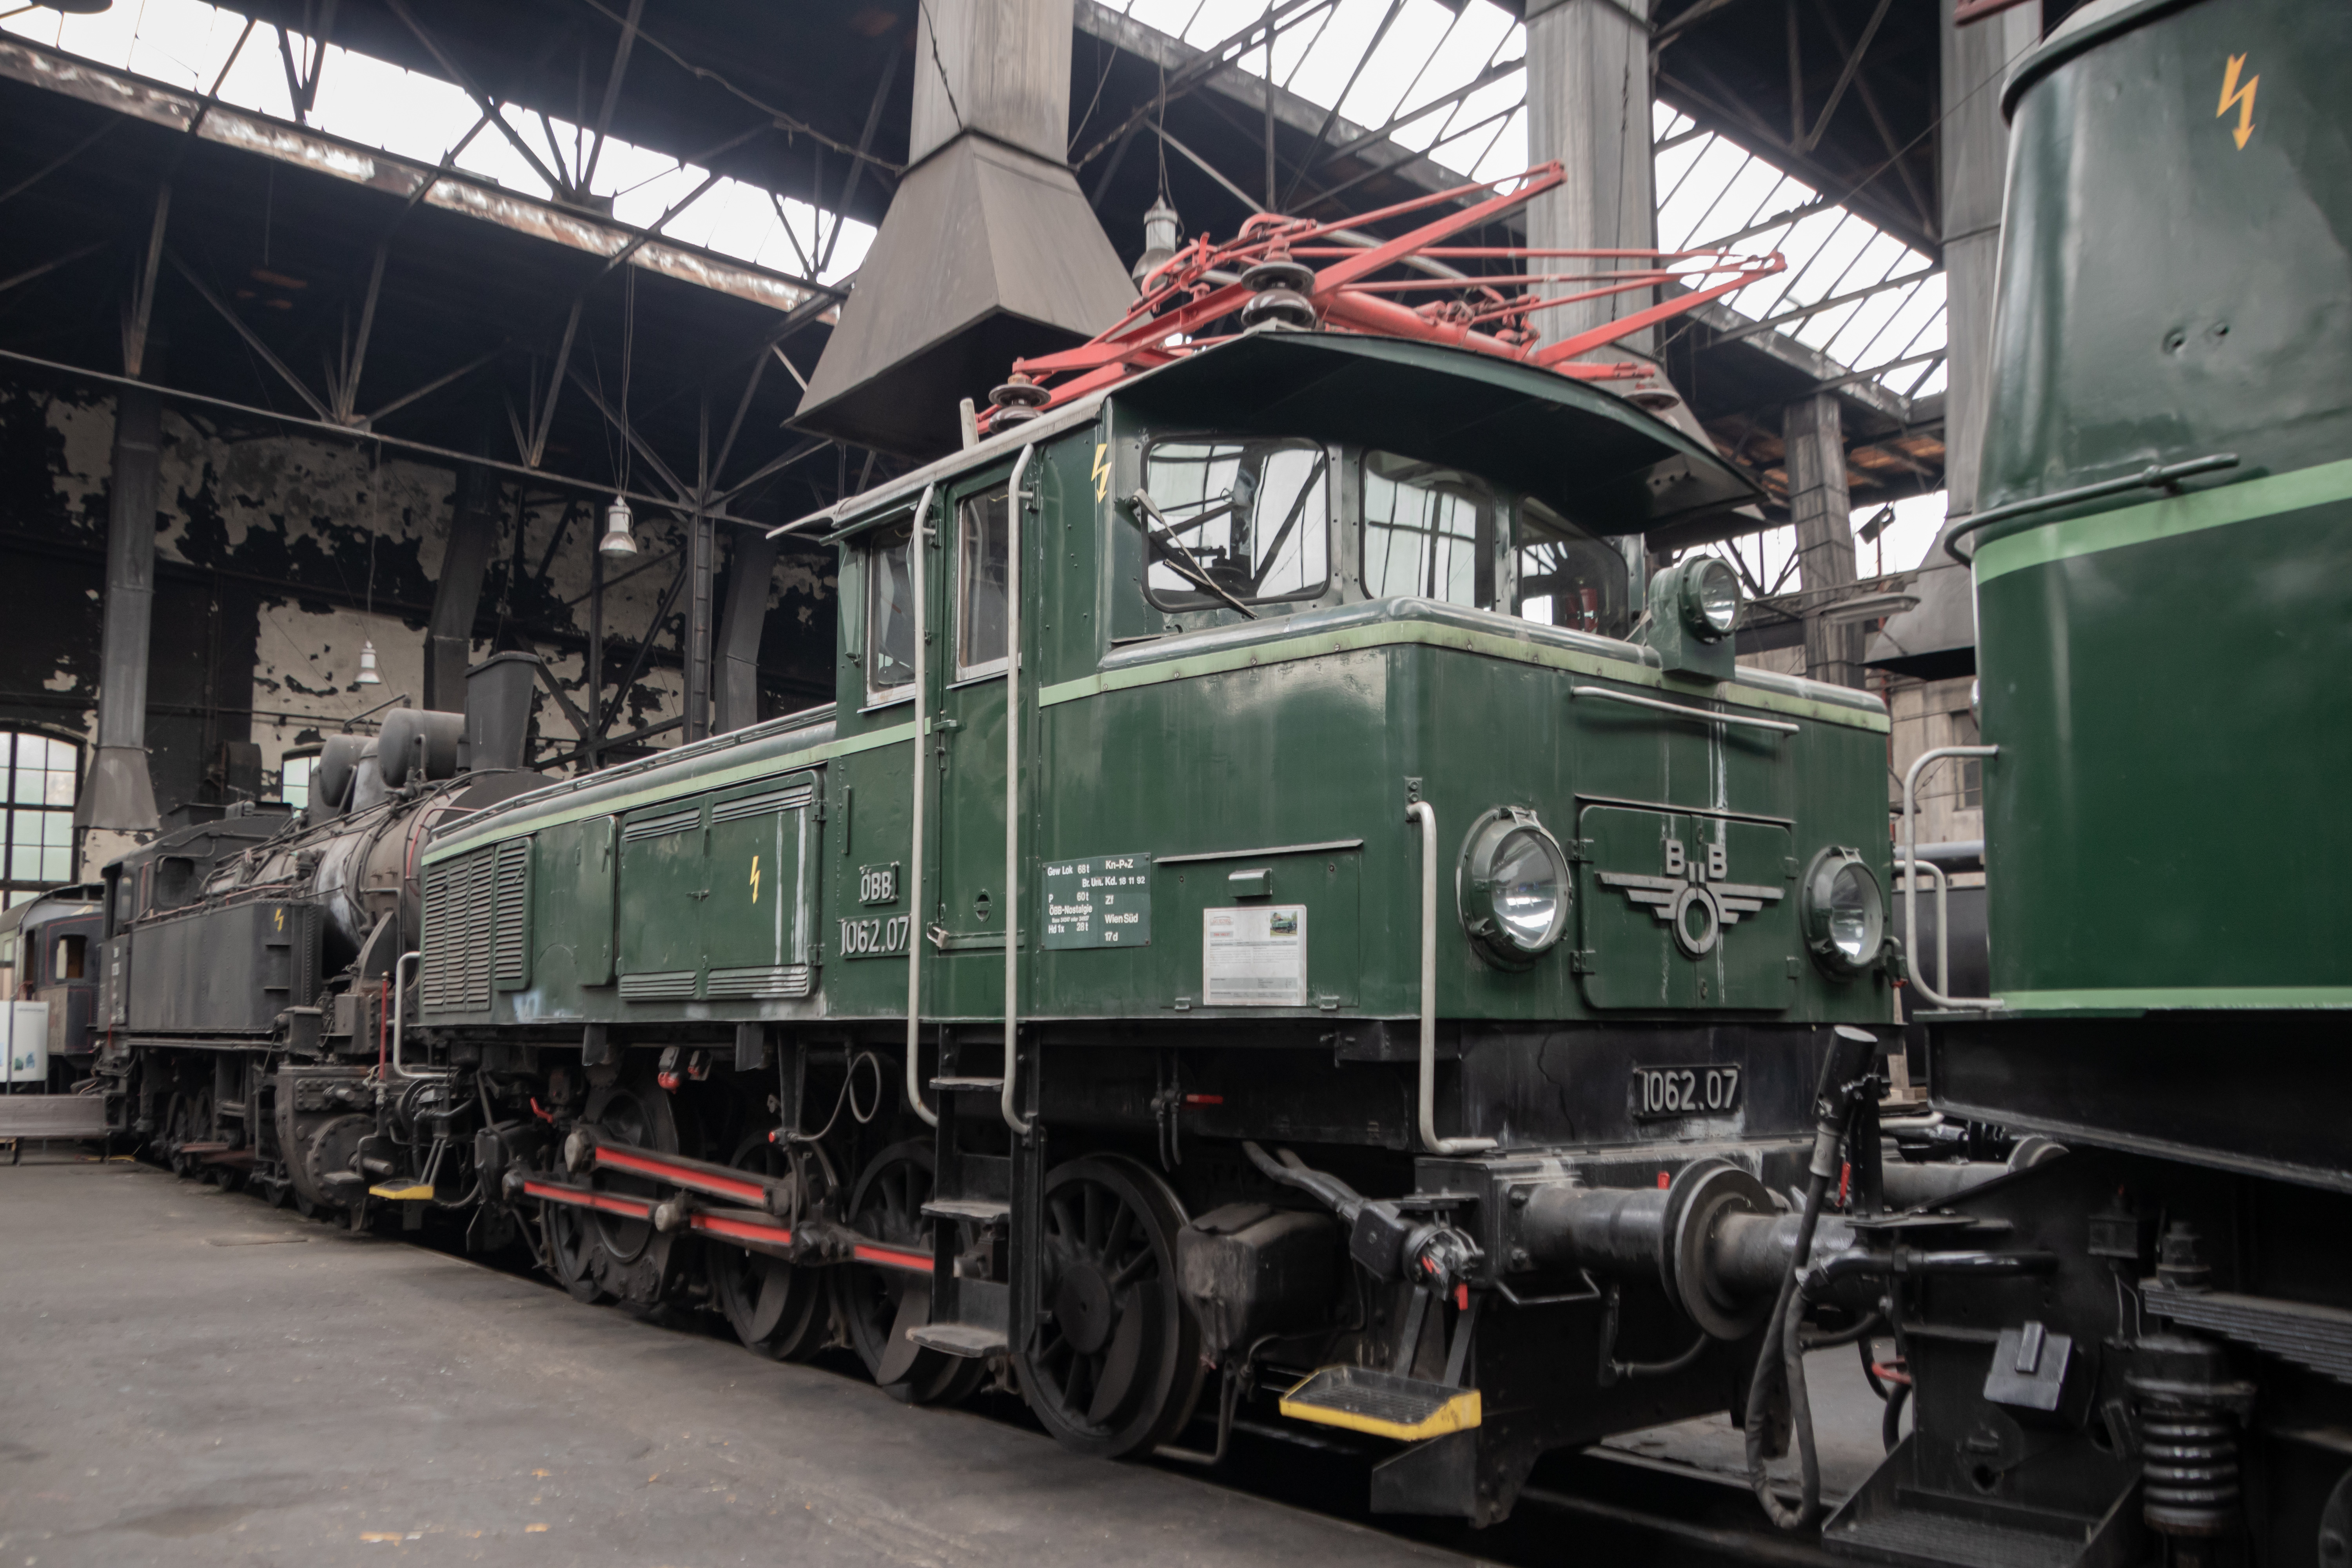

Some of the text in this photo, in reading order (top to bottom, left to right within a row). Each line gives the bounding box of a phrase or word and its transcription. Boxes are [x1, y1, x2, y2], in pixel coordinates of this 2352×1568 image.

[1047, 866, 1060, 876] Gew
[1062, 865, 1073, 875] Lok
[861, 868, 892, 900] ÖBB
[1082, 878, 1090, 887] Br.
[1105, 876, 1117, 886] Kd.
[1119, 877, 1126, 885] 18
[1136, 876, 1145, 884] 92
[1105, 895, 1114, 905] Zf
[1049, 904, 1093, 915] ÖBB-Nostalgie
[1105, 913, 1138, 924] Wien Süd
[841, 916, 909, 953] 1062.07
[1048, 924, 1057, 934] Hd
[1105, 931, 1118, 941] 17 d
[1640, 1069, 1738, 1112] 1062.07
